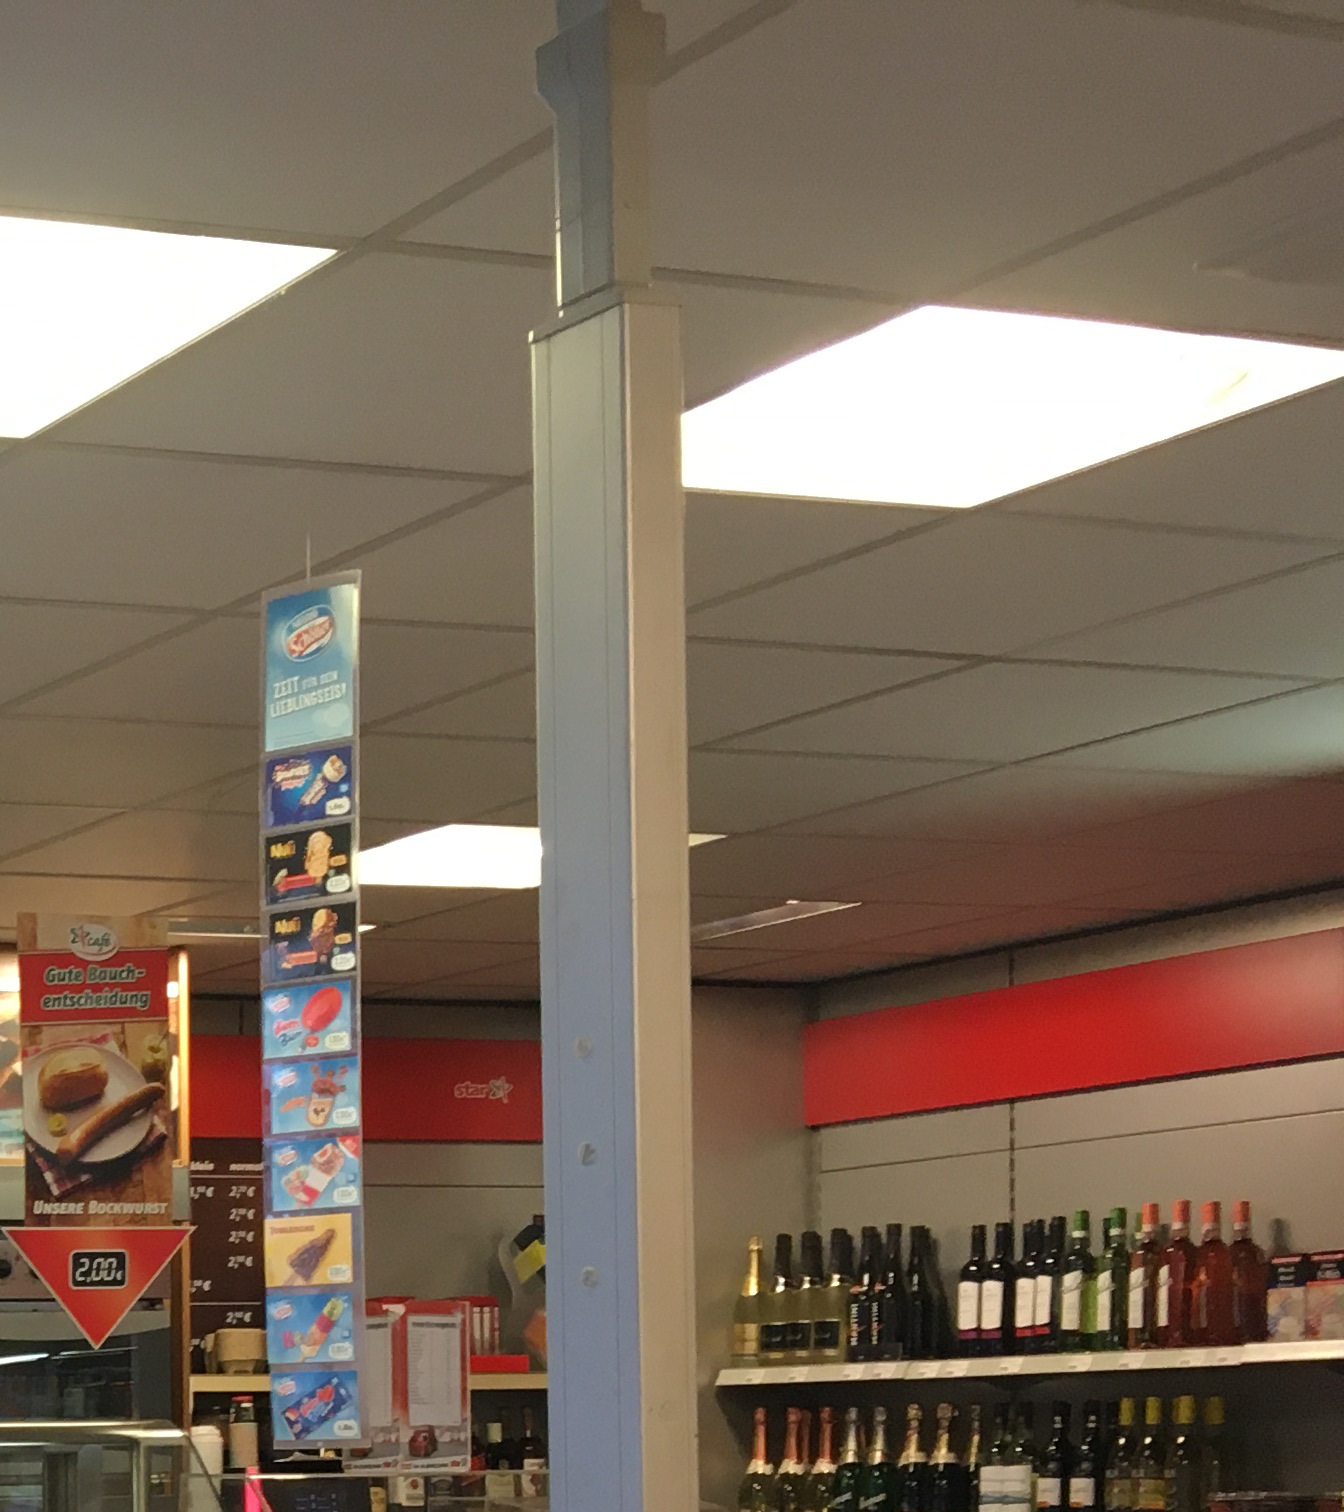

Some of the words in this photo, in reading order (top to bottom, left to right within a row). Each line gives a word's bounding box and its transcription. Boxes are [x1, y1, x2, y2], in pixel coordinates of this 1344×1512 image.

[274, 675, 301, 699] ZEIT
[271, 682, 347, 718] LIEBLINGSEIS!
[44, 966, 84, 985] Gute
[87, 963, 146, 983] Bauch-
[42, 988, 151, 1010] entscheidung
[454, 1081, 489, 1098] star
[33, 1201, 84, 1214] UNSERE
[88, 1201, 168, 1214] BOCKWURST
